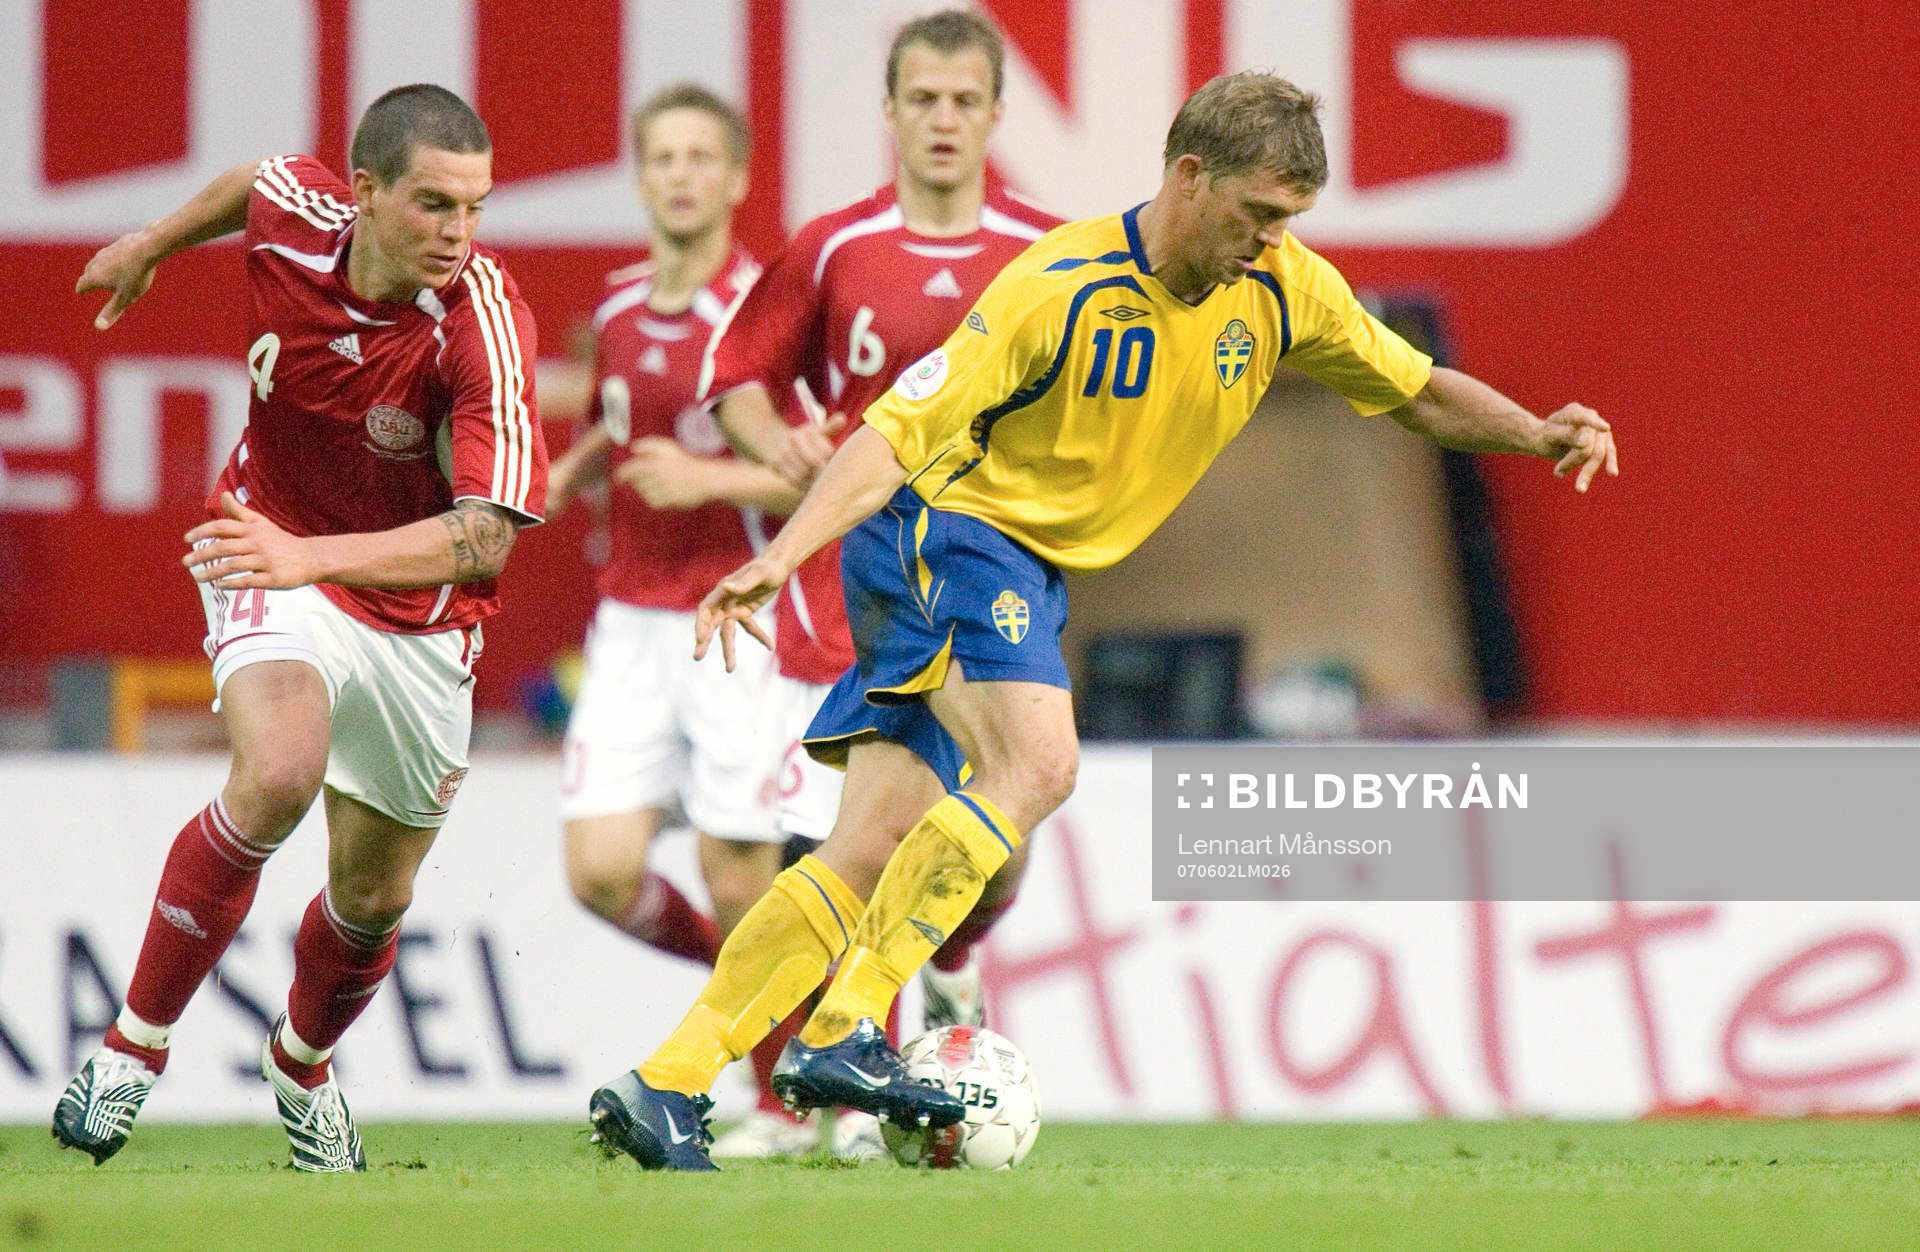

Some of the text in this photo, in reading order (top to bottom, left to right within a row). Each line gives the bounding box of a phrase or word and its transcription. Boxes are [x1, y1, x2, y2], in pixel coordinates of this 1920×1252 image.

[247, 332, 281, 403] 4
[328, 341, 365, 366] adidas
[847, 306, 887, 378] 6
[1082, 326, 1156, 399] 10
[230, 588, 270, 628] 4
